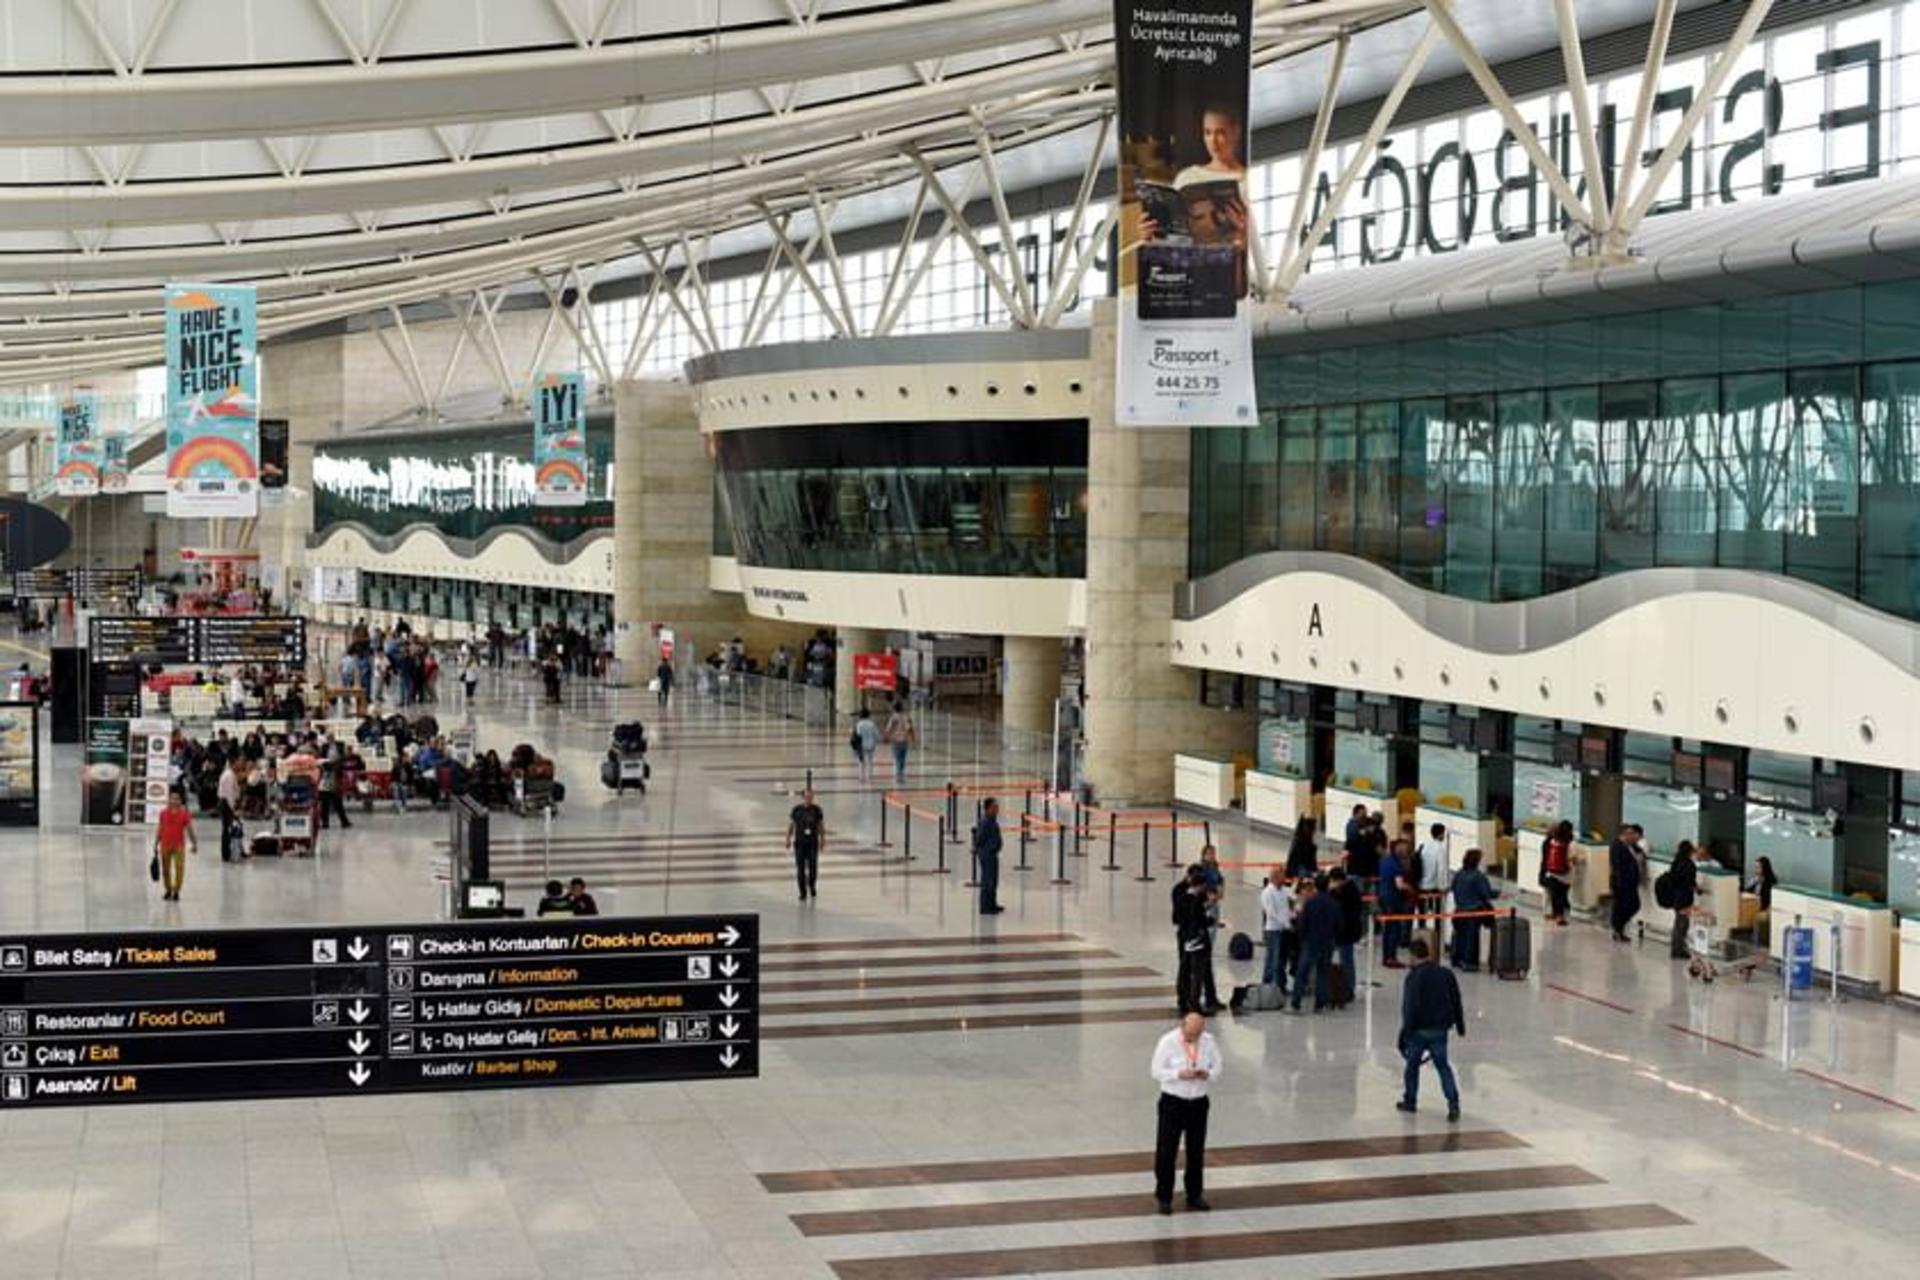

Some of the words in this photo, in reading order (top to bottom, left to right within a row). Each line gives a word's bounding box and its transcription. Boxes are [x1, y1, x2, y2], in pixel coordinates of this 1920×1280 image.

[1133, 9, 1237, 25] Havalimanında
[1131, 23, 1187, 41] Ücretsiz
[1190, 28, 1241, 46] Lounge
[181, 306, 225, 335] HAVE
[181, 329, 242, 370] NICE
[1154, 347, 1219, 366] Passport
[180, 365, 243, 395] FLIGHT
[1156, 376, 1180, 388] 444
[1184, 376, 1199, 389] 25
[1308, 603, 1323, 637] A
[420, 938, 486, 954] Check-in
[571, 934, 579, 949] /
[581, 932, 645, 949] Check-in
[650, 931, 714, 946] Counters
[34, 950, 70, 966] Bilet
[115, 949, 122, 964] /
[125, 947, 170, 963] Ticket
[174, 946, 217, 962] Sales
[421, 971, 486, 989] Danışma
[489, 969, 496, 984] /
[498, 967, 578, 984] Information
[438, 1002, 482, 1017] Hatlar
[524, 998, 532, 1014] /
[534, 996, 600, 1013] Domestic
[605, 994, 682, 1012] Departures
[35, 1013, 125, 1030] Restoranlar
[128, 1013, 135, 1028] /
[138, 1011, 177, 1026] Food
[181, 1009, 225, 1025] Court
[468, 1032, 504, 1046] Hatlar
[540, 1028, 547, 1043] /
[612, 1025, 656, 1039] Arrivals
[79, 1046, 86, 1061] /
[89, 1045, 119, 1061] Exit
[467, 1060, 475, 1076] /
[476, 1060, 520, 1075] Barber
[523, 1059, 557, 1074] Shop
[35, 1076, 99, 1094] Asansör
[102, 1076, 110, 1092] /
[112, 1075, 138, 1091] Lift
